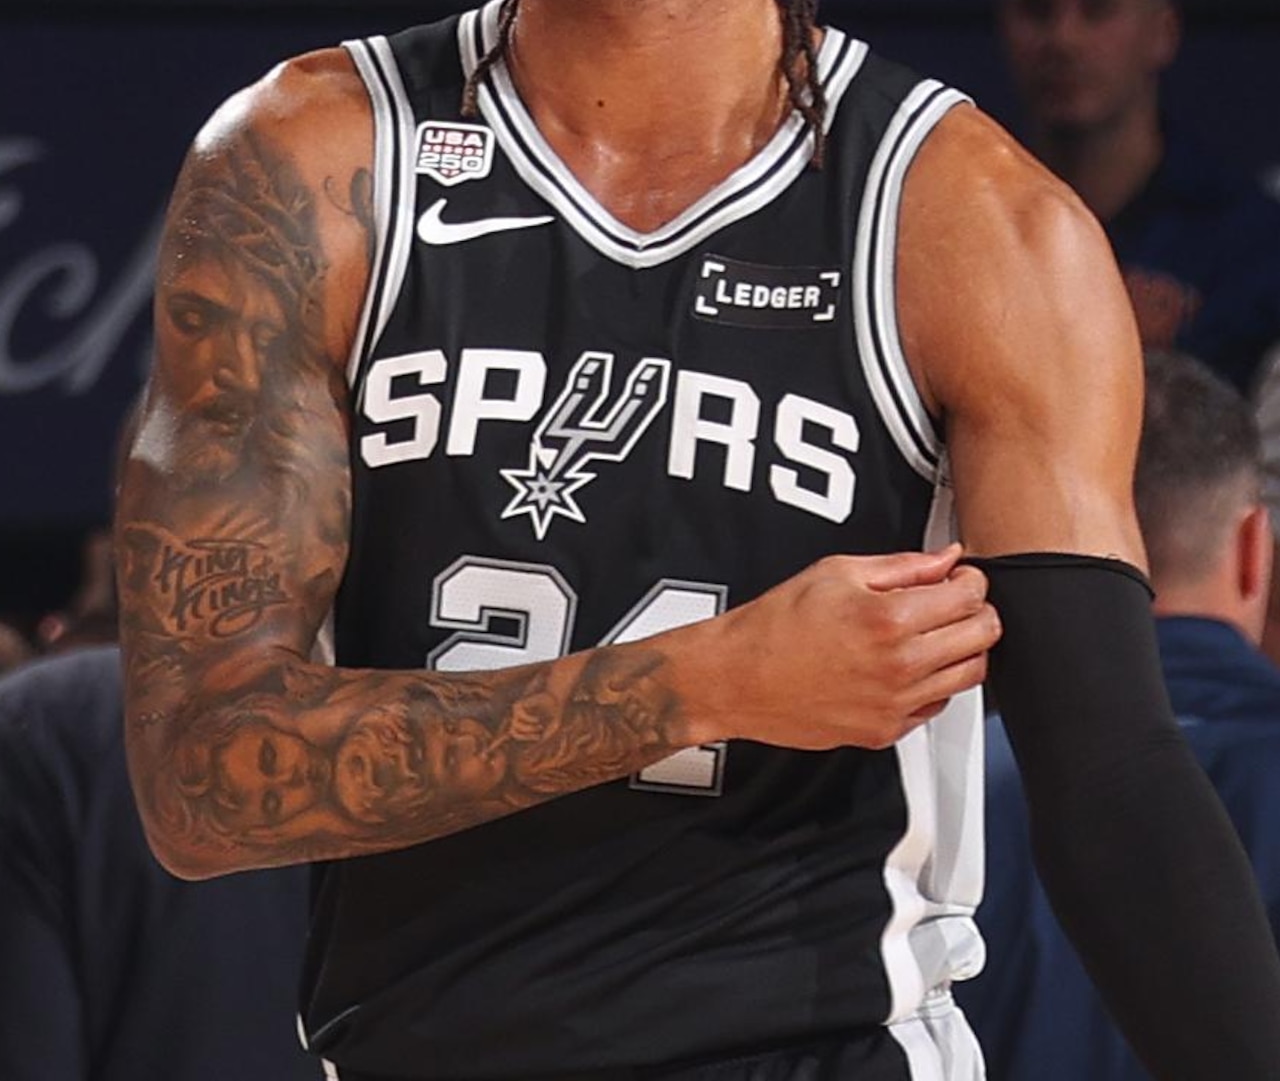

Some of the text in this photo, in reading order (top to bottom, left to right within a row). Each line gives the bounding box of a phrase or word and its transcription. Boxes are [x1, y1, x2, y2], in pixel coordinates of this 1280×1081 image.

[425, 129, 483, 147] USA
[420, 152, 483, 171] 250
[715, 279, 821, 308] LEDGER
[361, 349, 860, 540] SPURS
